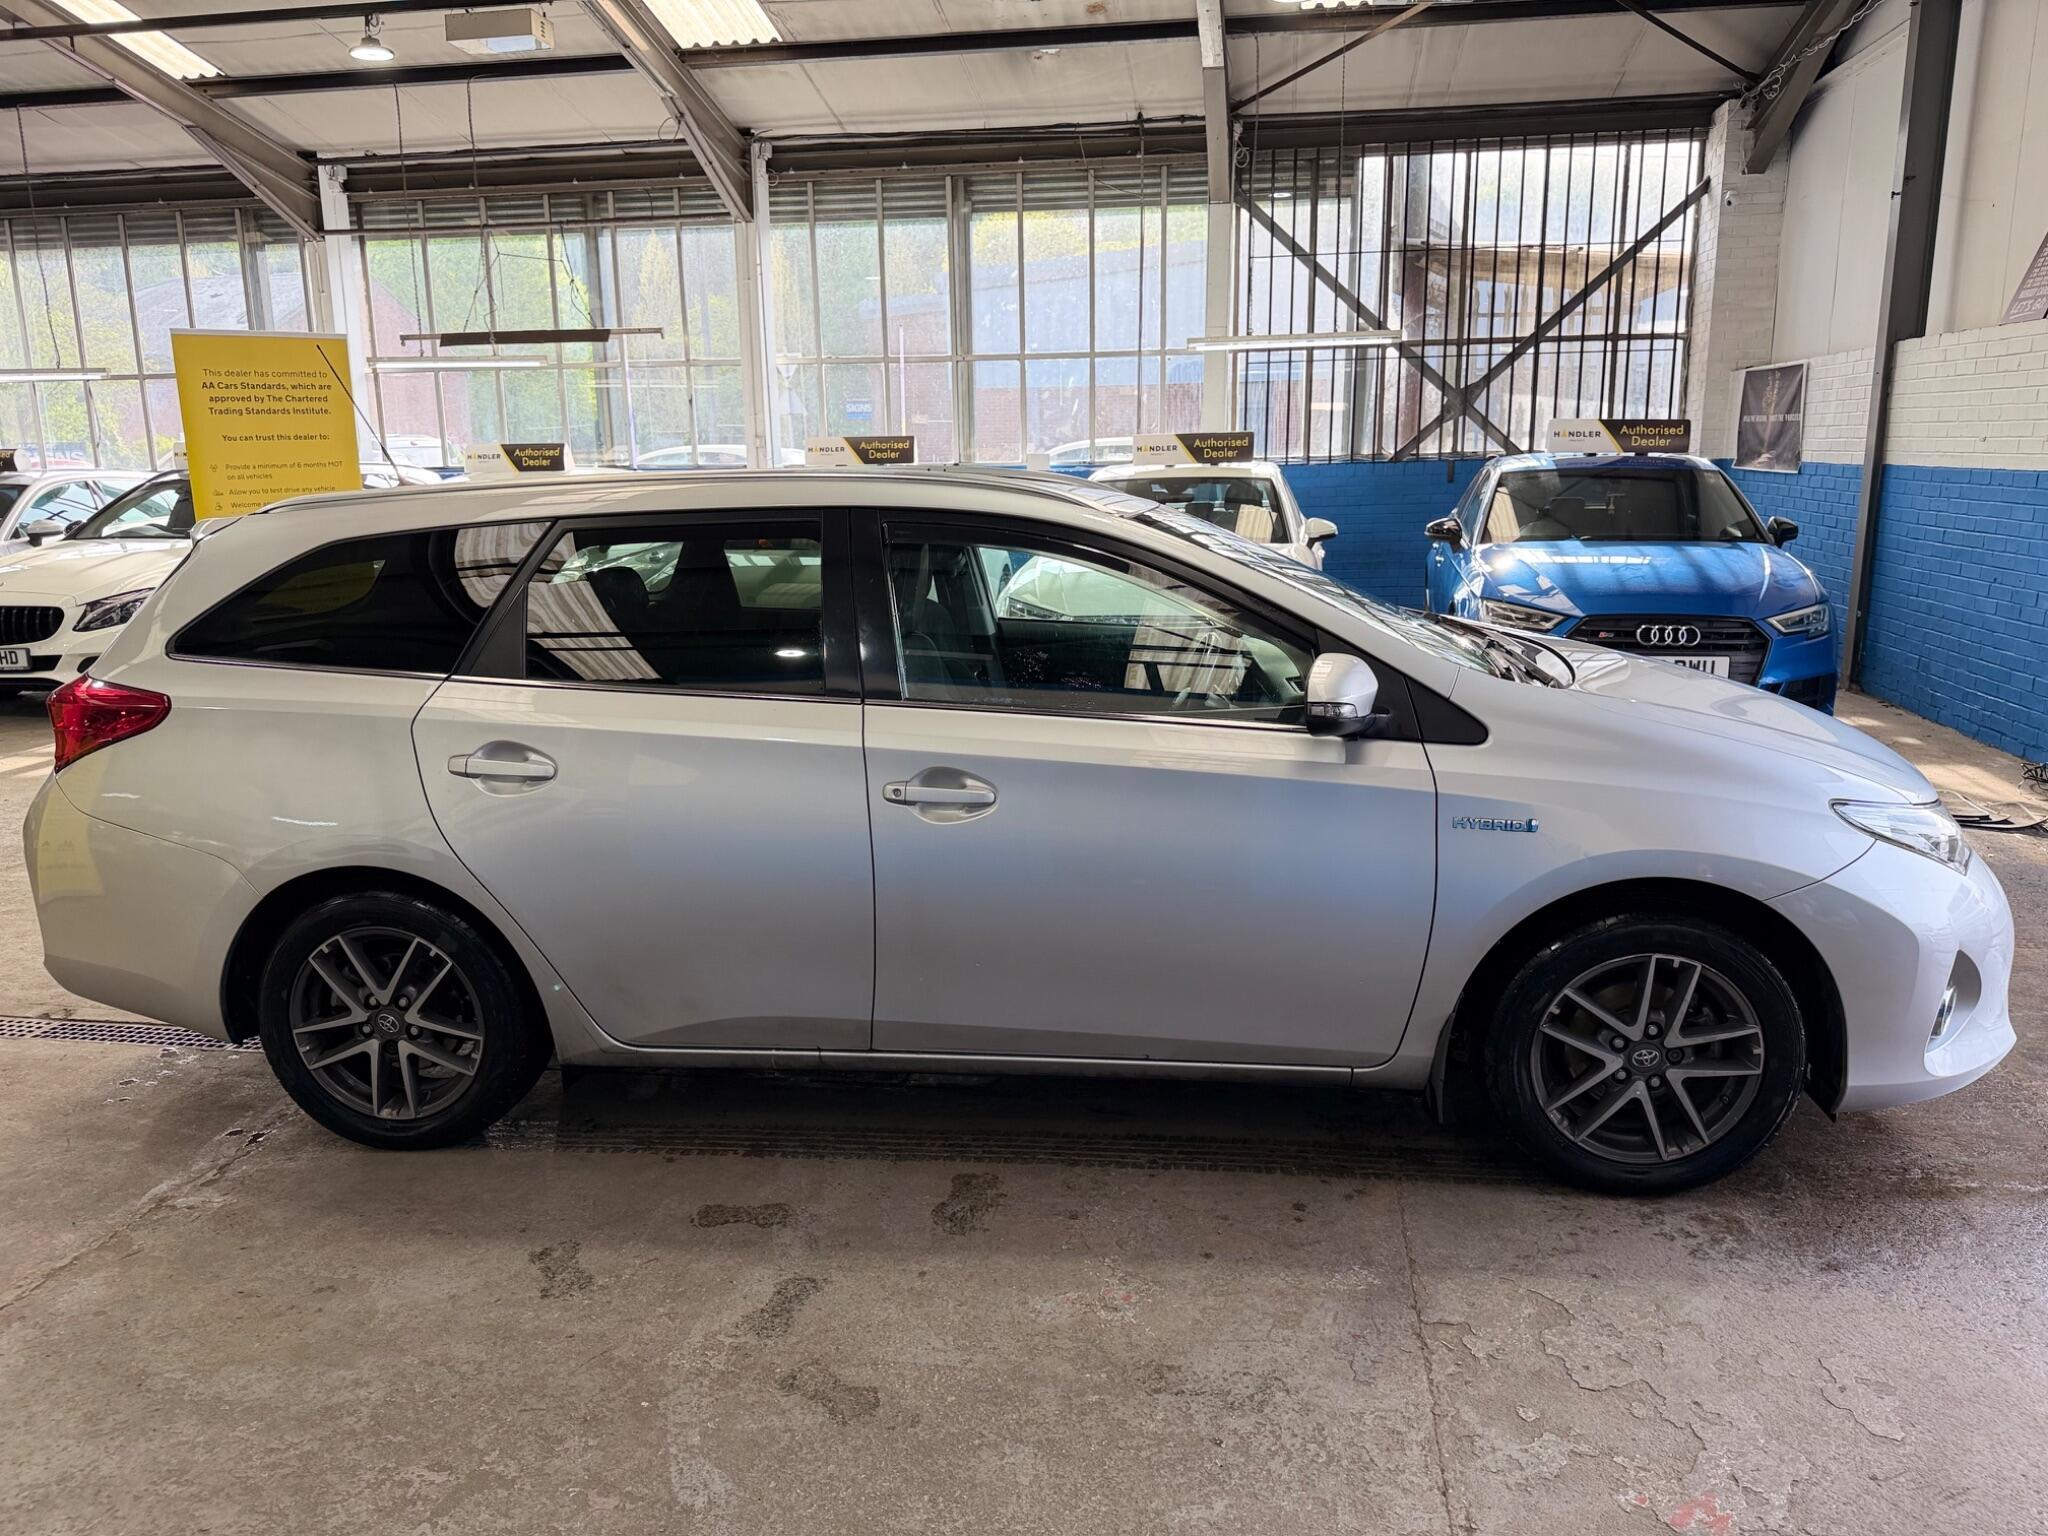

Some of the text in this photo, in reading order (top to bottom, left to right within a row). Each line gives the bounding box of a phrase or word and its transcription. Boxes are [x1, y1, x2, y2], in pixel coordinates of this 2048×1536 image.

[202, 368, 328, 378] This dealer has committed to
[201, 381, 215, 390] AA
[217, 381, 239, 390] Cars
[240, 381, 289, 391] Standards,
[290, 382, 317, 390] which
[208, 394, 328, 403] approved by The Chartered
[208, 406, 332, 416] Trading Standards Institute.
[1619, 424, 1684, 435] Authorised
[859, 440, 910, 449] Authorised
[1193, 437, 1249, 448] Authorised
[1631, 436, 1672, 447] Dealer
[513, 448, 560, 457] Authorised
[868, 450, 900, 459] Dealer
[1203, 448, 1238, 458] Dealer
[521, 457, 552, 466] Dealer
[248, 488, 260, 496] you
[230, 501, 262, 509] Welcome
[1452, 816, 1525, 832] HYBRID
